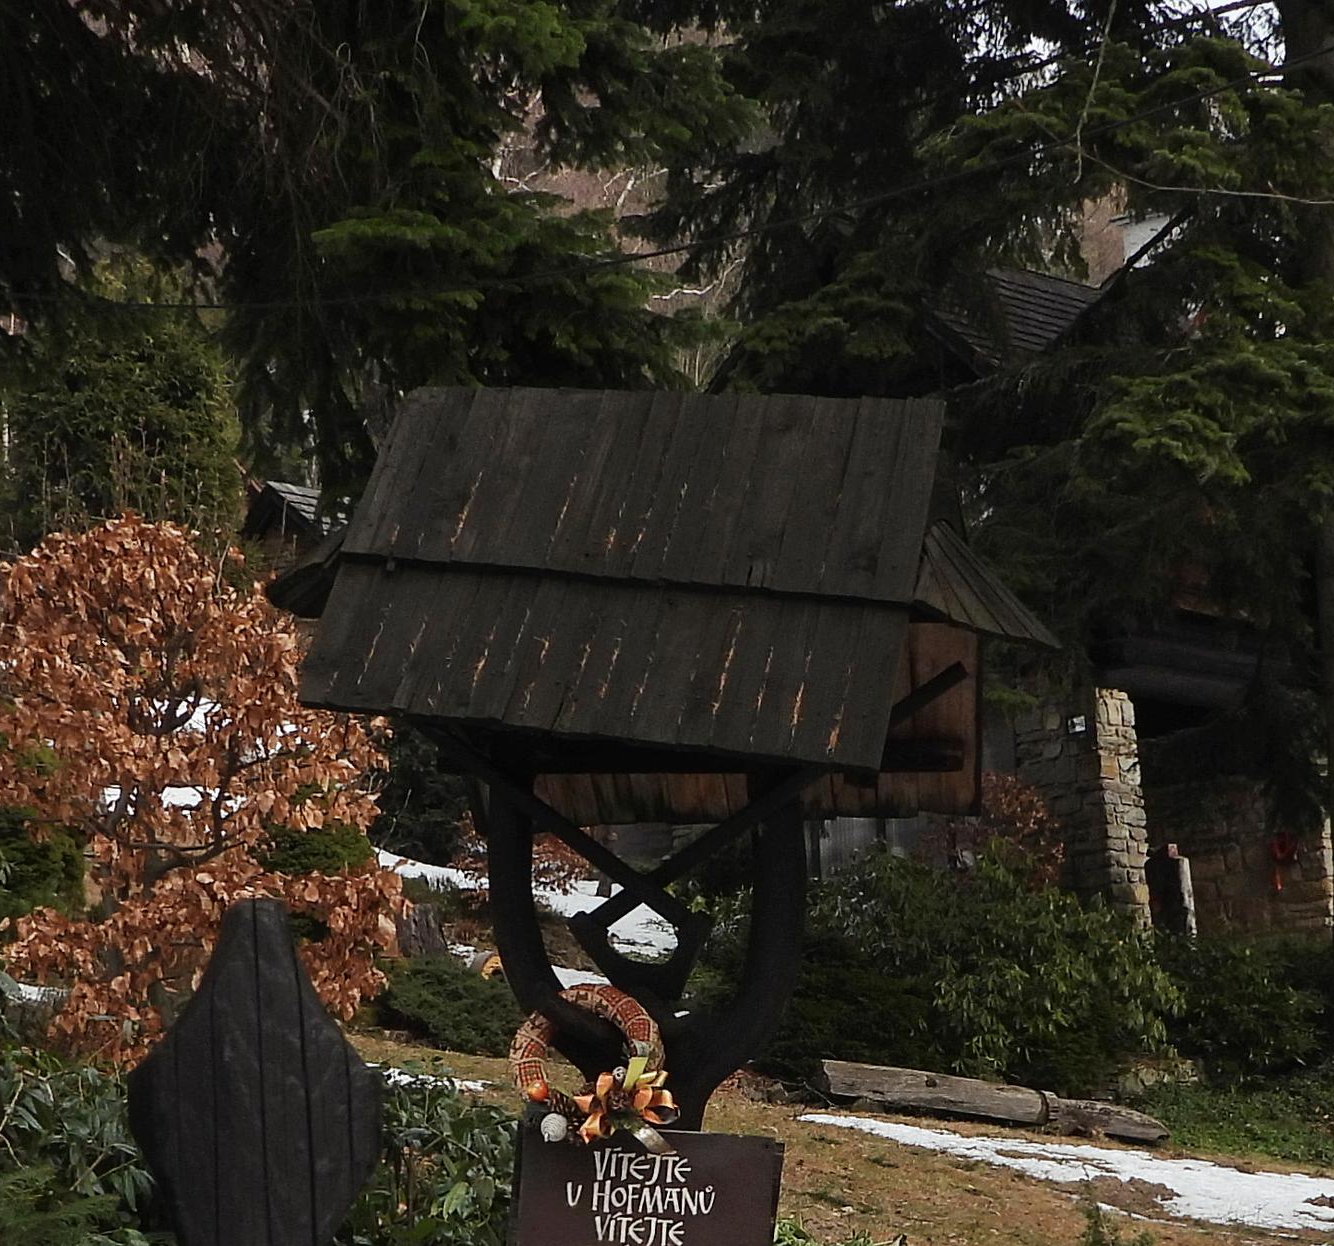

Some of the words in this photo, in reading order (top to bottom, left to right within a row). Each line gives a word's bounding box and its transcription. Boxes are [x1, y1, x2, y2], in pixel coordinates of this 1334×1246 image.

[594, 1147, 692, 1185] VÍTEJTE
[567, 1181, 583, 1207] U
[592, 1179, 715, 1215] HOFMANŮ
